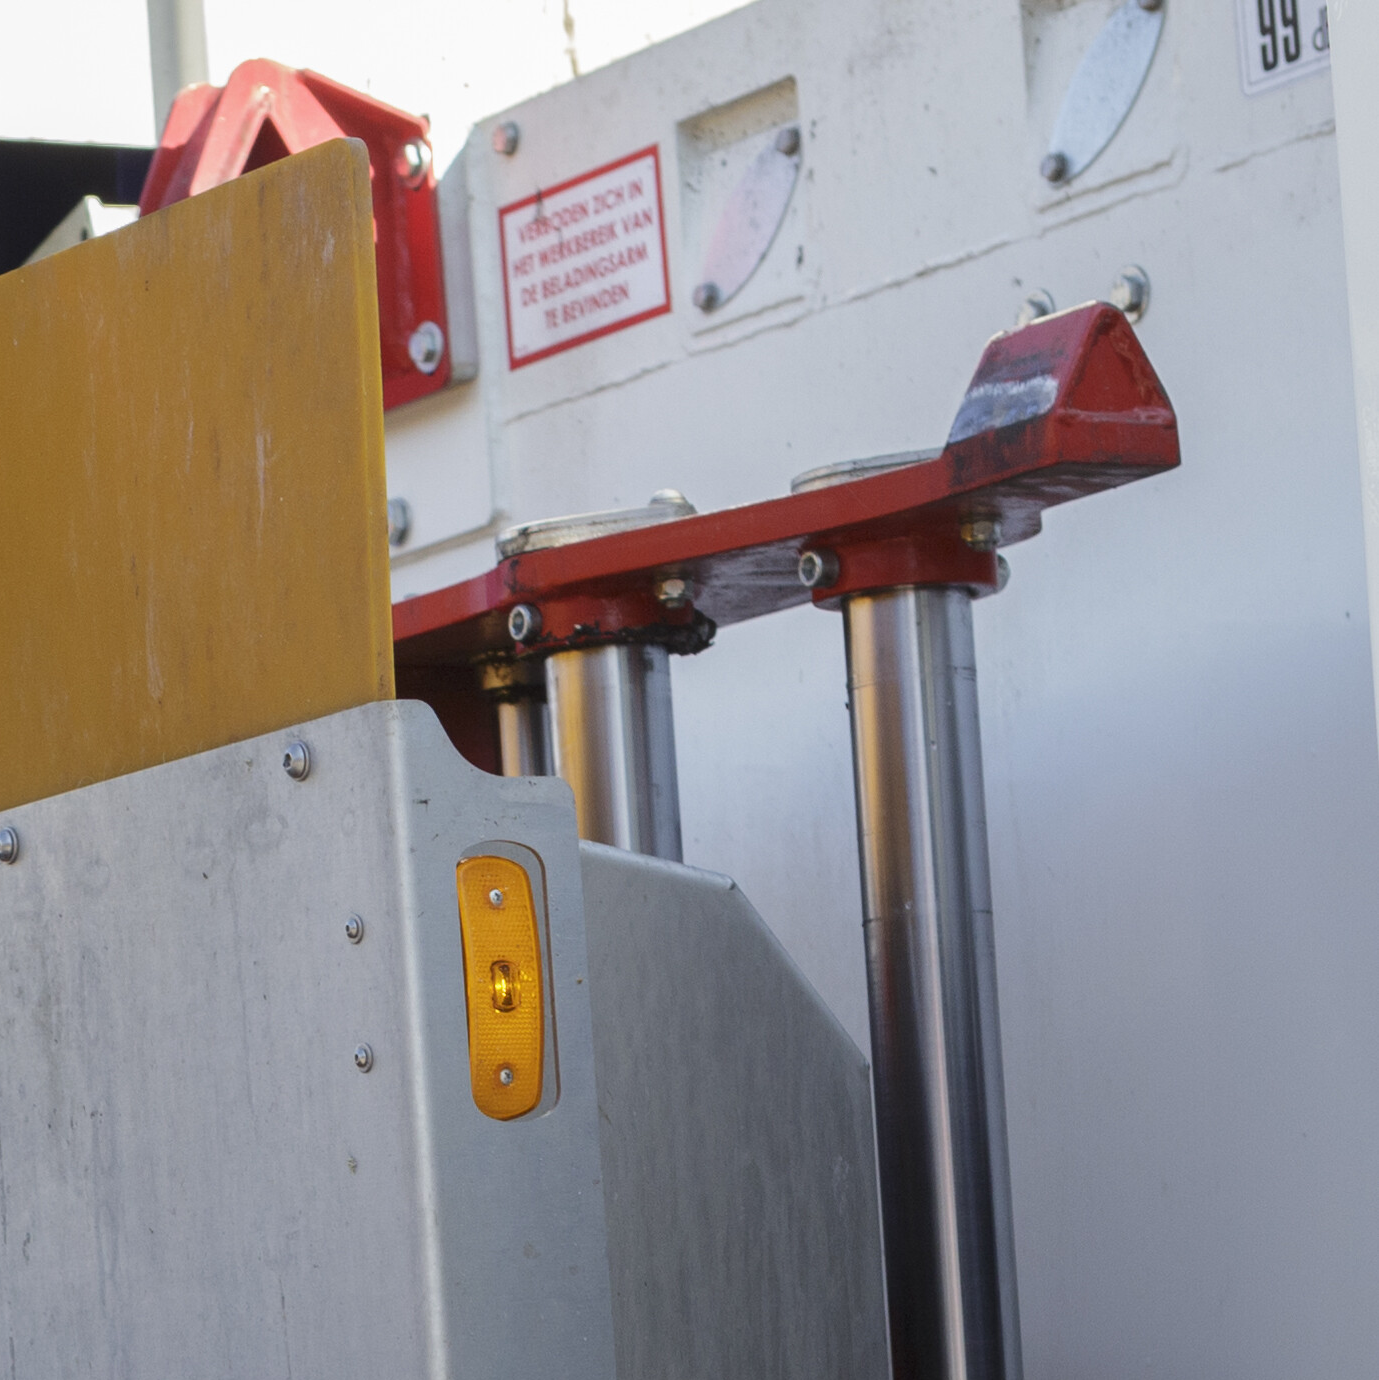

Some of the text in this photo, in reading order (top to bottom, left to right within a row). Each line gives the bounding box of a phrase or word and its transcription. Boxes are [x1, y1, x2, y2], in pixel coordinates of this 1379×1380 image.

[512, 206, 653, 279] HET WERKBEREIK VAN
[518, 177, 644, 243] VERBODEN ZICH IN
[520, 240, 649, 308] DE BELADINGSARM
[544, 280, 630, 330] TE BEVINDEN
